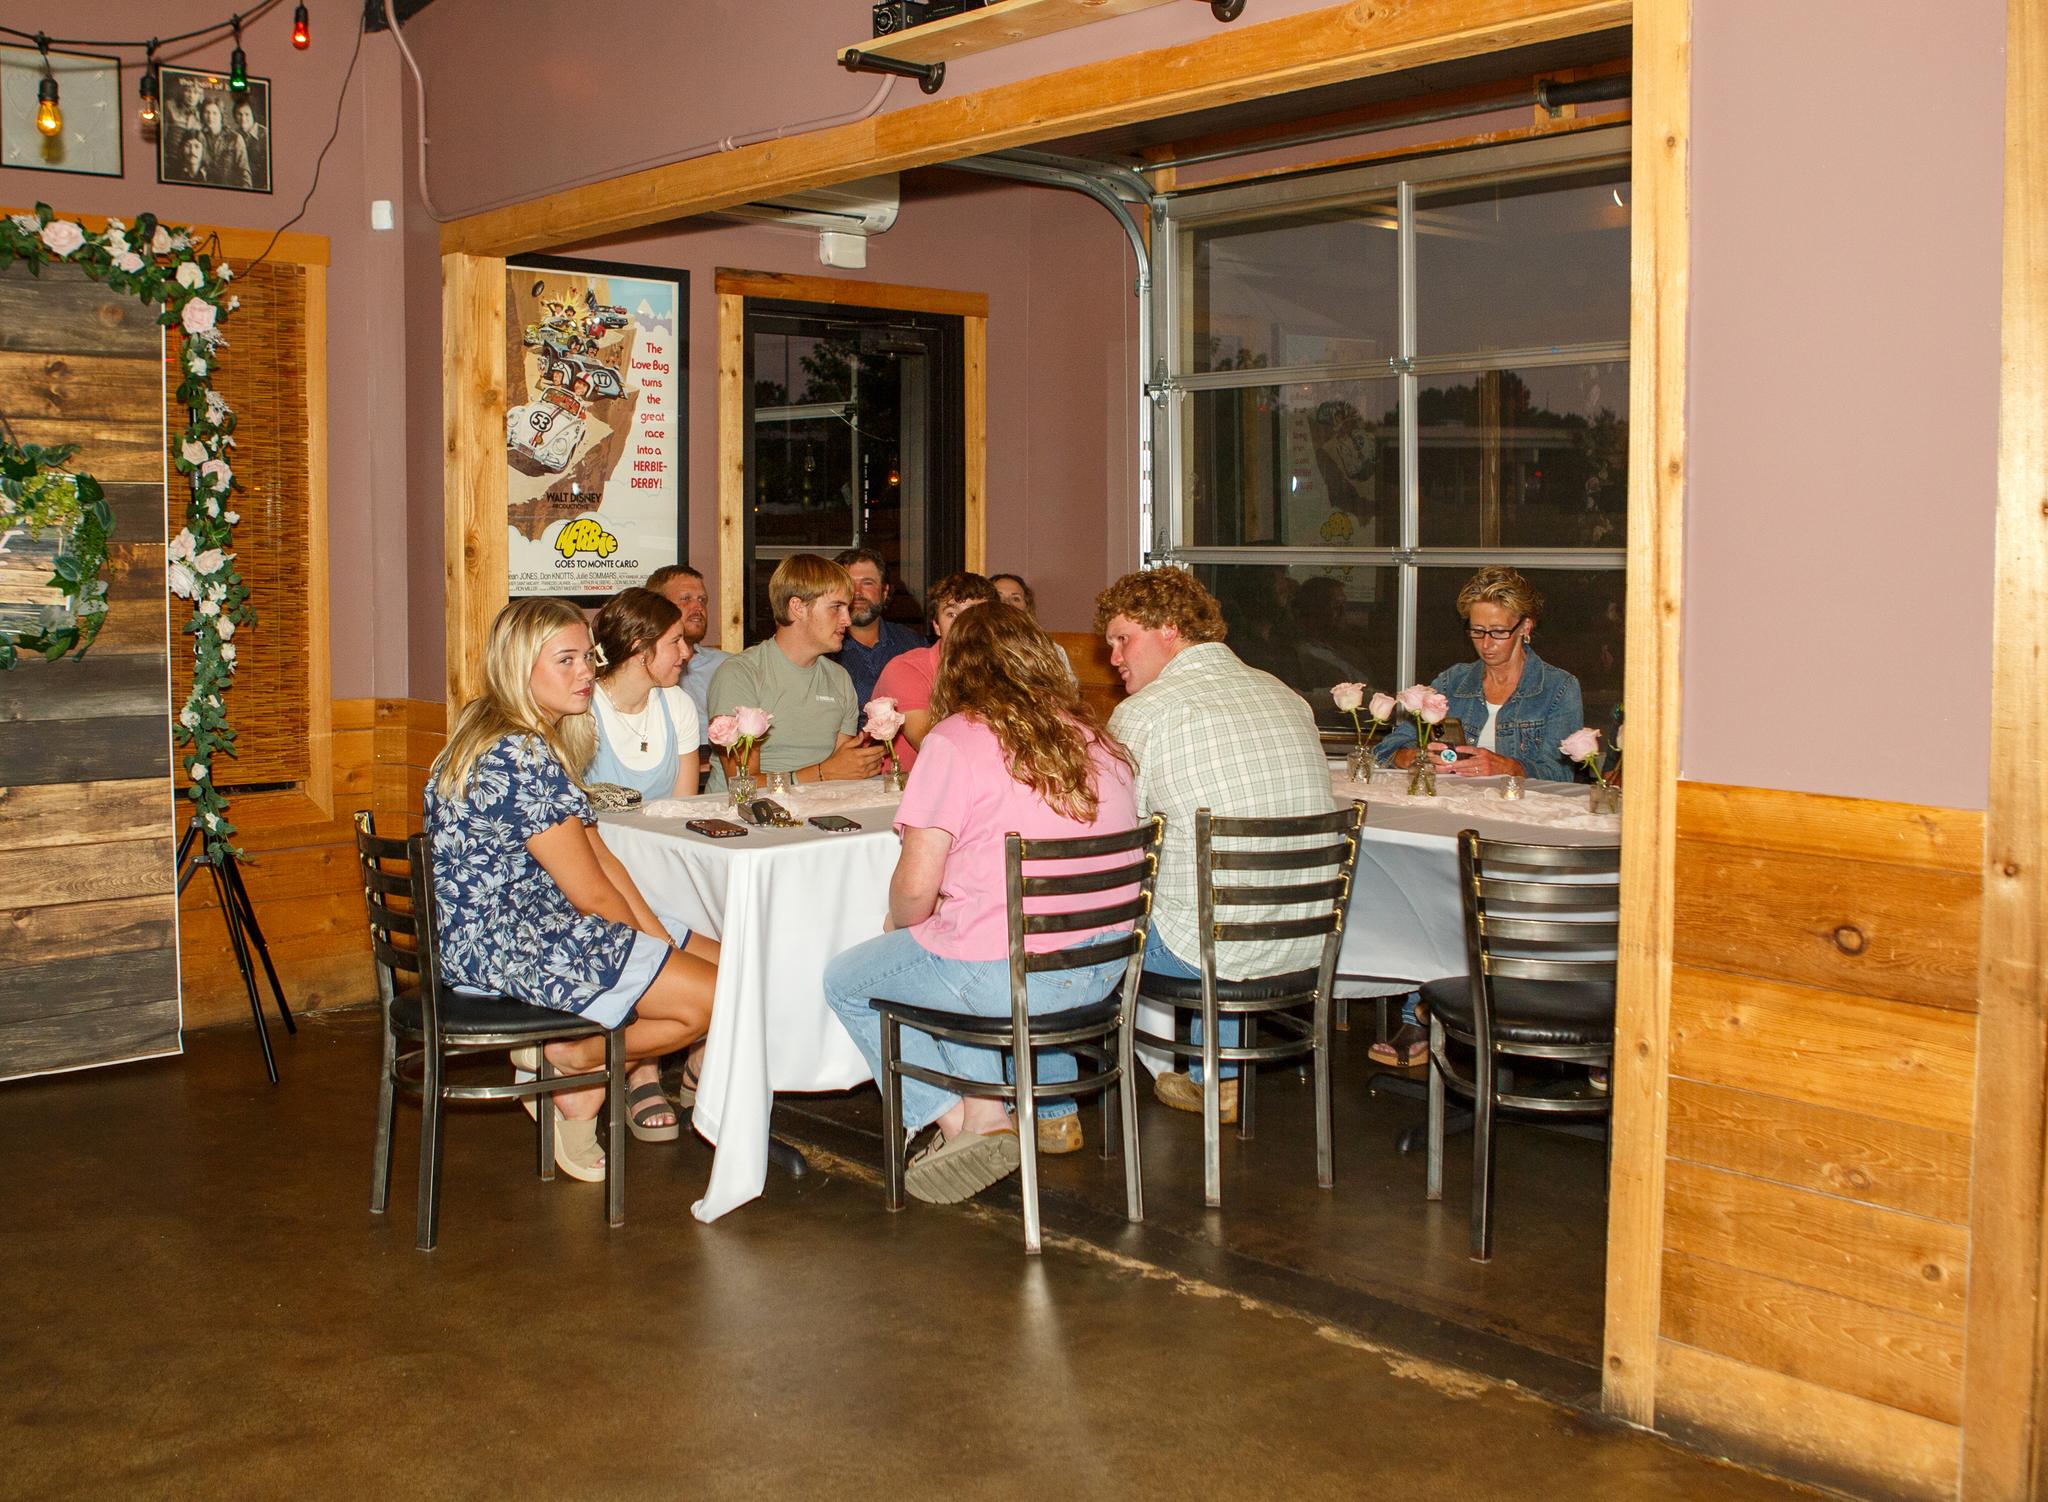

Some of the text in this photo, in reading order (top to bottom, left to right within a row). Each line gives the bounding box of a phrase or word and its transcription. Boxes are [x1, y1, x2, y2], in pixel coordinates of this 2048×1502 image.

[646, 342, 663, 354] The
[631, 358, 670, 374] Love Bug
[641, 378, 663, 388] turns
[647, 394, 661, 405] the
[532, 413, 551, 430] 53
[640, 412, 665, 424] great
[645, 430, 665, 438] race
[637, 445, 662, 455] into a
[633, 460, 668, 472] HERBIE-
[631, 477, 663, 489] DERBY!
[546, 491, 602, 503] WALT DISNEY
[555, 559, 639, 568] GOES TO MONTE CARLO
[540, 572, 551, 580] Don
